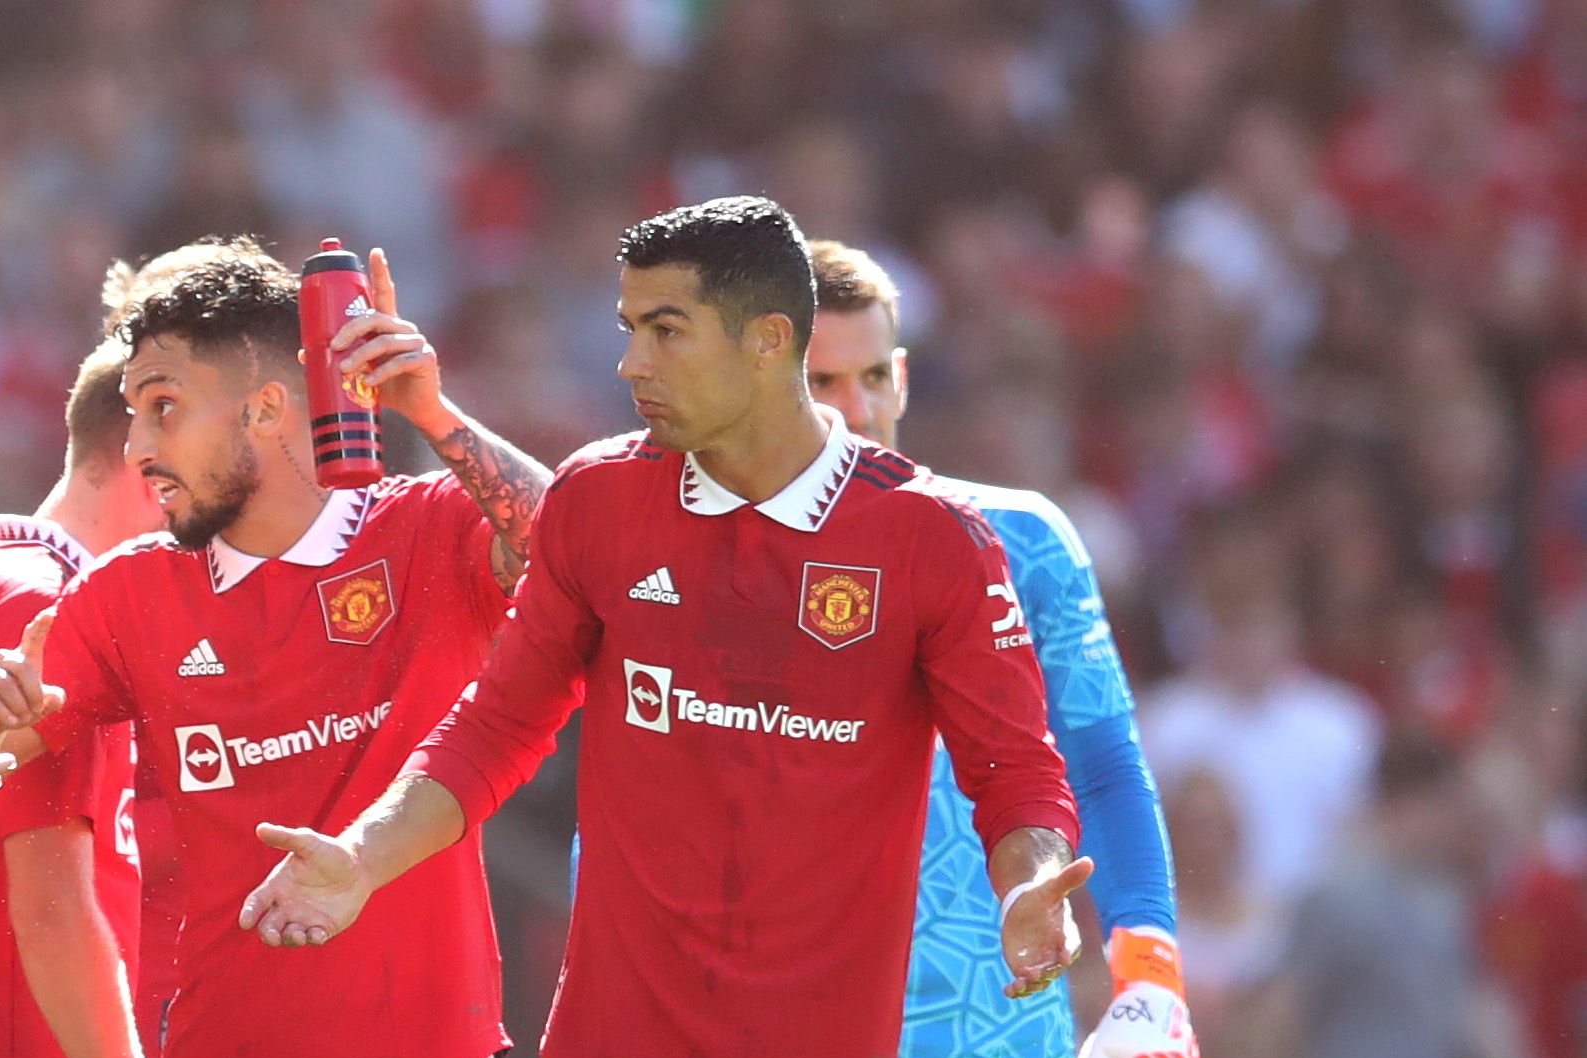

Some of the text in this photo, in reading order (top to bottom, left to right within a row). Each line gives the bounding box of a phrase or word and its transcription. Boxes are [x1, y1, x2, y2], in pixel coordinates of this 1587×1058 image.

[628, 587, 681, 605] adidas
[178, 661, 226, 676] adidas
[672, 688, 865, 742] TeamViewer
